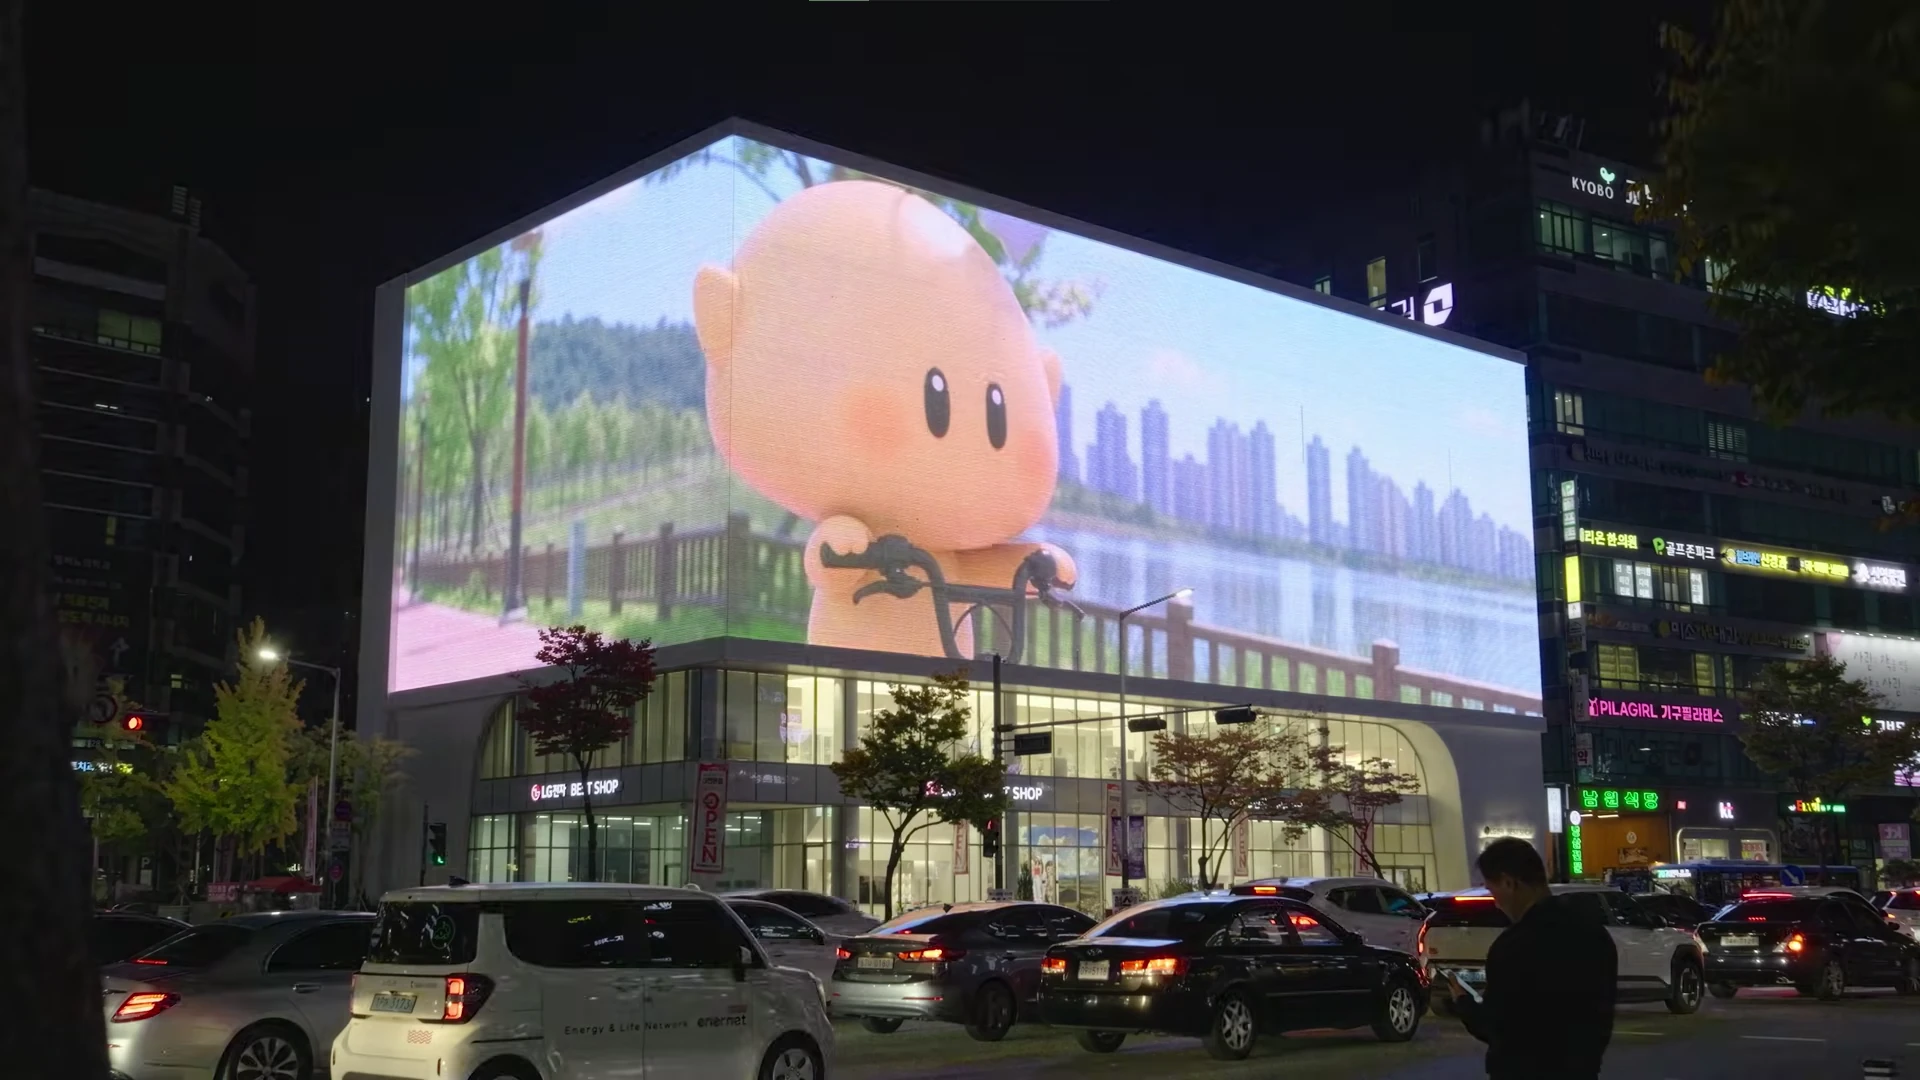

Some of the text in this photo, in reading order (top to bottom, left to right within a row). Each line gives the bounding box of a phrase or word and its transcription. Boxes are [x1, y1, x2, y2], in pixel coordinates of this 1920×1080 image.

[1572, 176, 1614, 199] KYOBO
[1606, 532, 1639, 550] 한의원
[1665, 541, 1716, 560] 골프존파크
[1600, 700, 1658, 719] PILAGIRL
[1660, 704, 1724, 723] 기구필라테스
[541, 779, 619, 799] LG전자 BET SHOP
[1012, 786, 1043, 801] SHOP
[1582, 789, 1659, 809] 남원식당
[1718, 802, 1735, 818] kt
[564, 1020, 689, 1035] Energy & Life Network
[697, 1013, 748, 1029] enernet
